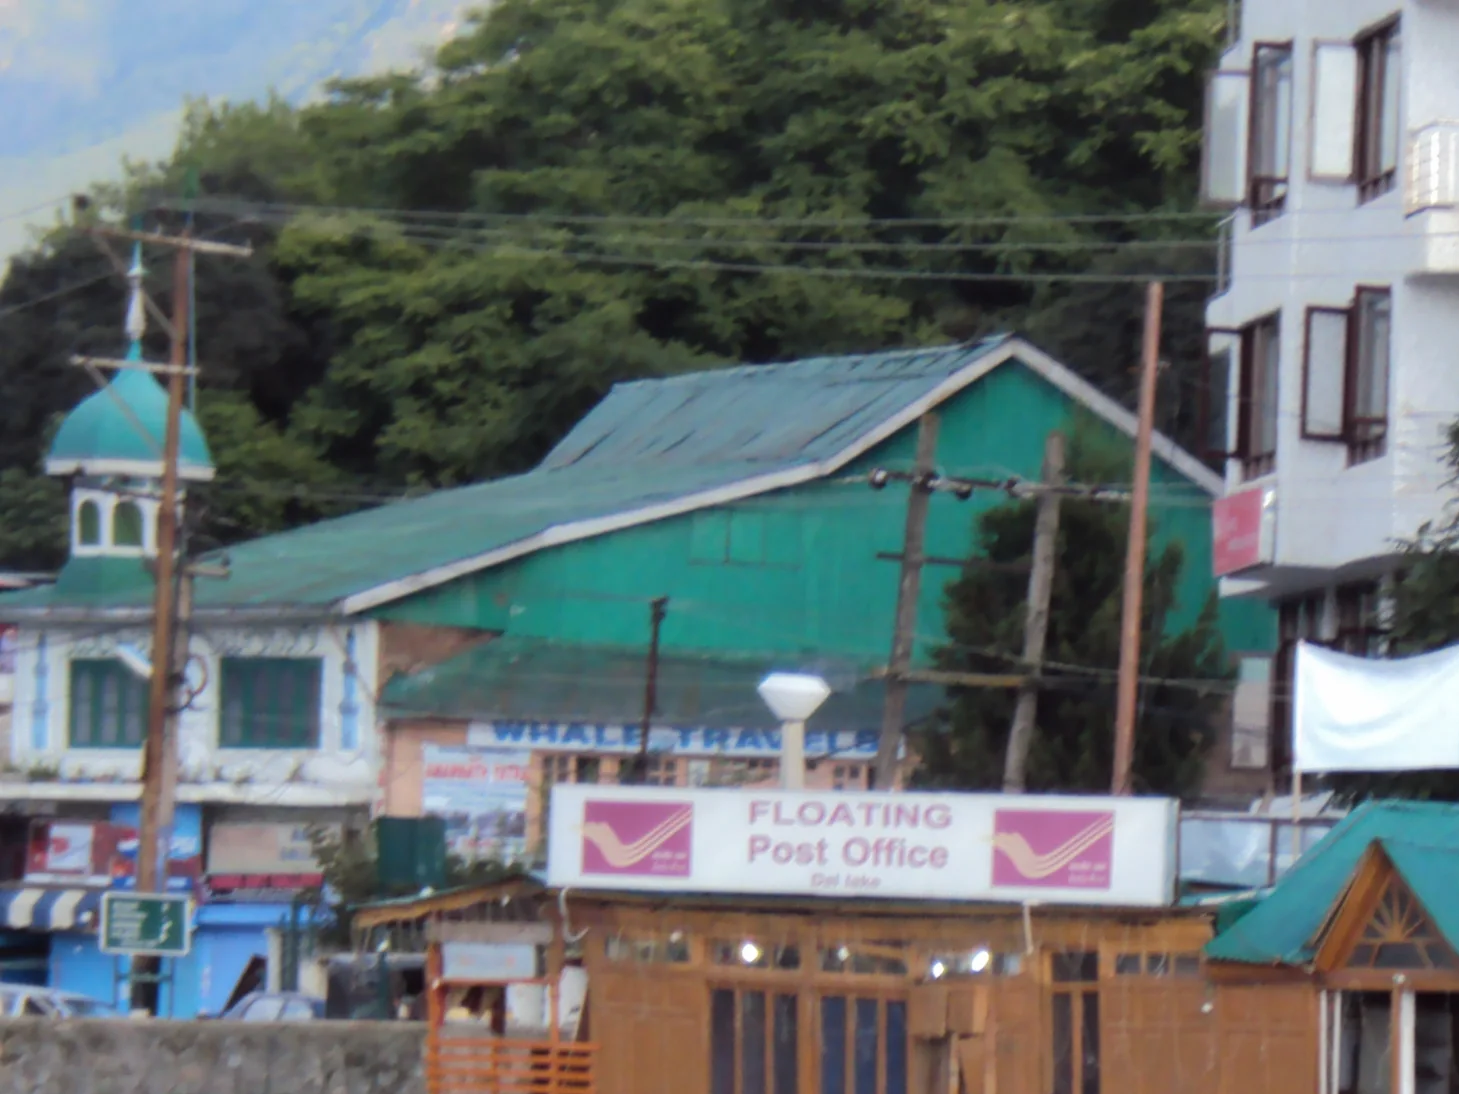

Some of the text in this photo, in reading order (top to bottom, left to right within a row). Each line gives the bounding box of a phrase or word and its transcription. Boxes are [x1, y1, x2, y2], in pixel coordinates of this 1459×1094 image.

[492, 720, 880, 752] WHALE TRAVELS
[748, 799, 953, 829] FLOATING
[748, 834, 949, 868] Post Office
